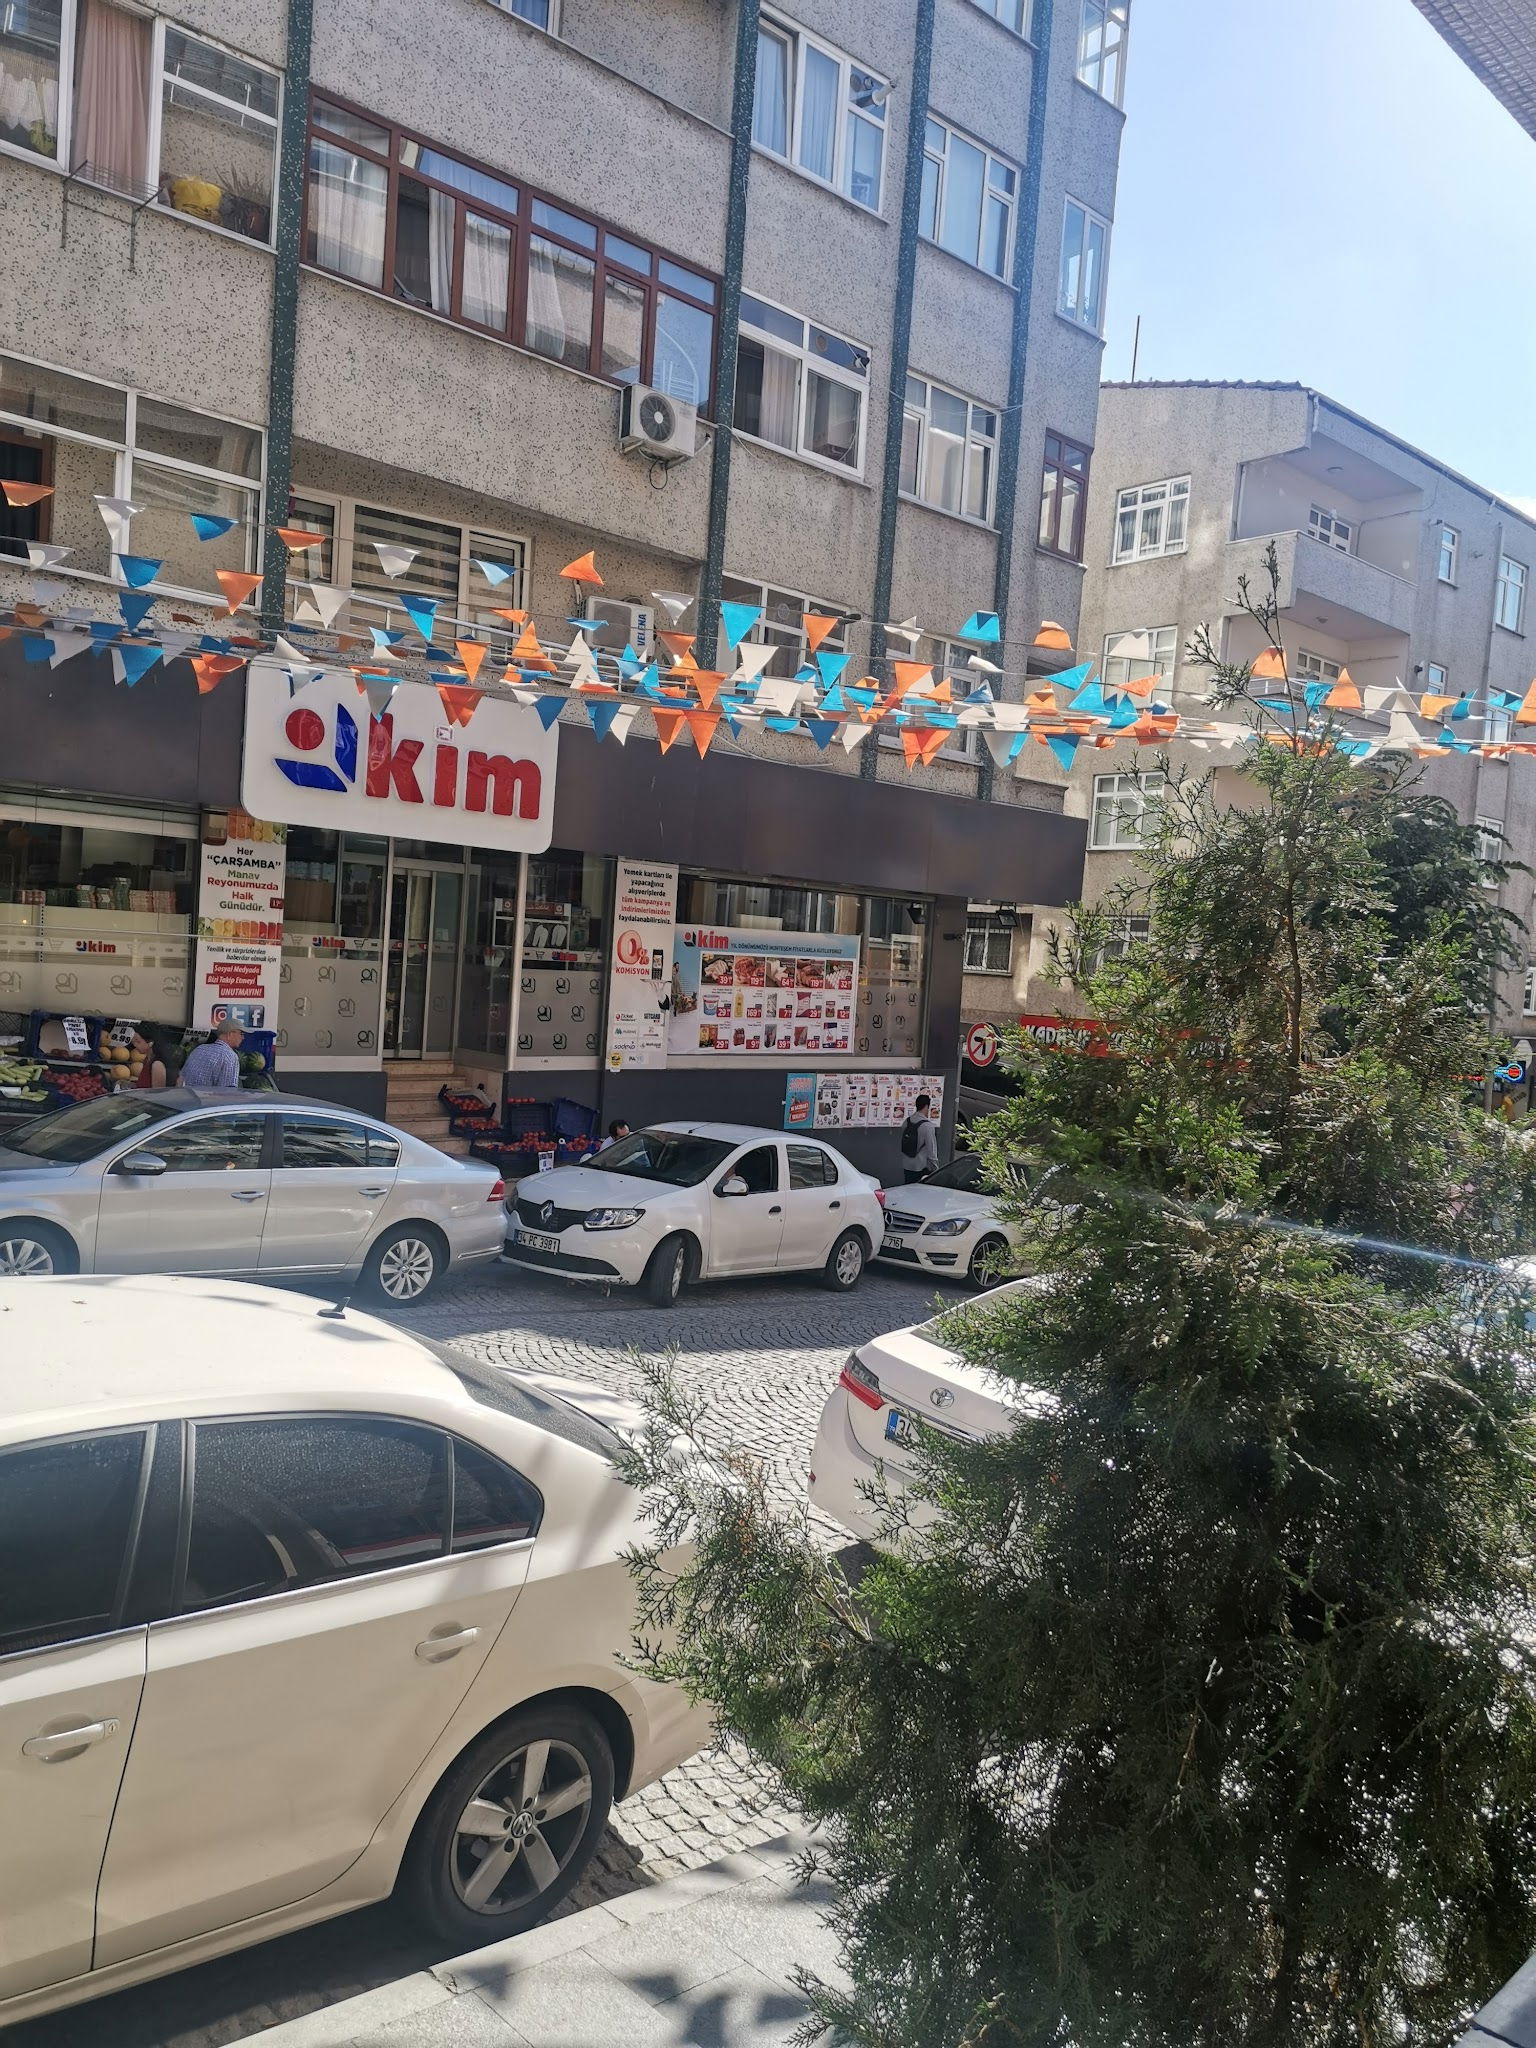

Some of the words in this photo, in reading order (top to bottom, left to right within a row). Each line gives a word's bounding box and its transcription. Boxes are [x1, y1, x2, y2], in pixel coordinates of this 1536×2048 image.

[365, 712, 542, 820] kim
[236, 846, 254, 856] Her
[227, 869, 260, 880] Manav
[623, 868, 643, 877] Yemek
[644, 870, 665, 879] kartları
[207, 876, 279, 891] Reyonumuzda
[630, 880, 665, 888] yapacağınız
[231, 890, 254, 901] Halk
[628, 887, 666, 897] alışverişlerde
[219, 900, 265, 912] Günüdür.
[634, 897, 664, 907] kampanya
[620, 905, 671, 916] indirimlerimizden
[618, 914, 672, 925] faydalanabilirsiniz.
[322, 936, 346, 948] kim
[697, 930, 729, 950] kim
[88, 940, 116, 953] kim
[232, 946, 266, 955] sürprizlerden
[214, 964, 233, 974] Sosyal
[234, 965, 260, 975] Medyada
[220, 976, 235, 985] Takip
[236, 977, 256, 986] Etmeyi
[220, 988, 262, 997] UNUTMAYIN!
[528, 1234, 538, 1247] PC
[539, 1238, 557, 1251] 3981
[888, 1238, 900, 1248] 716
